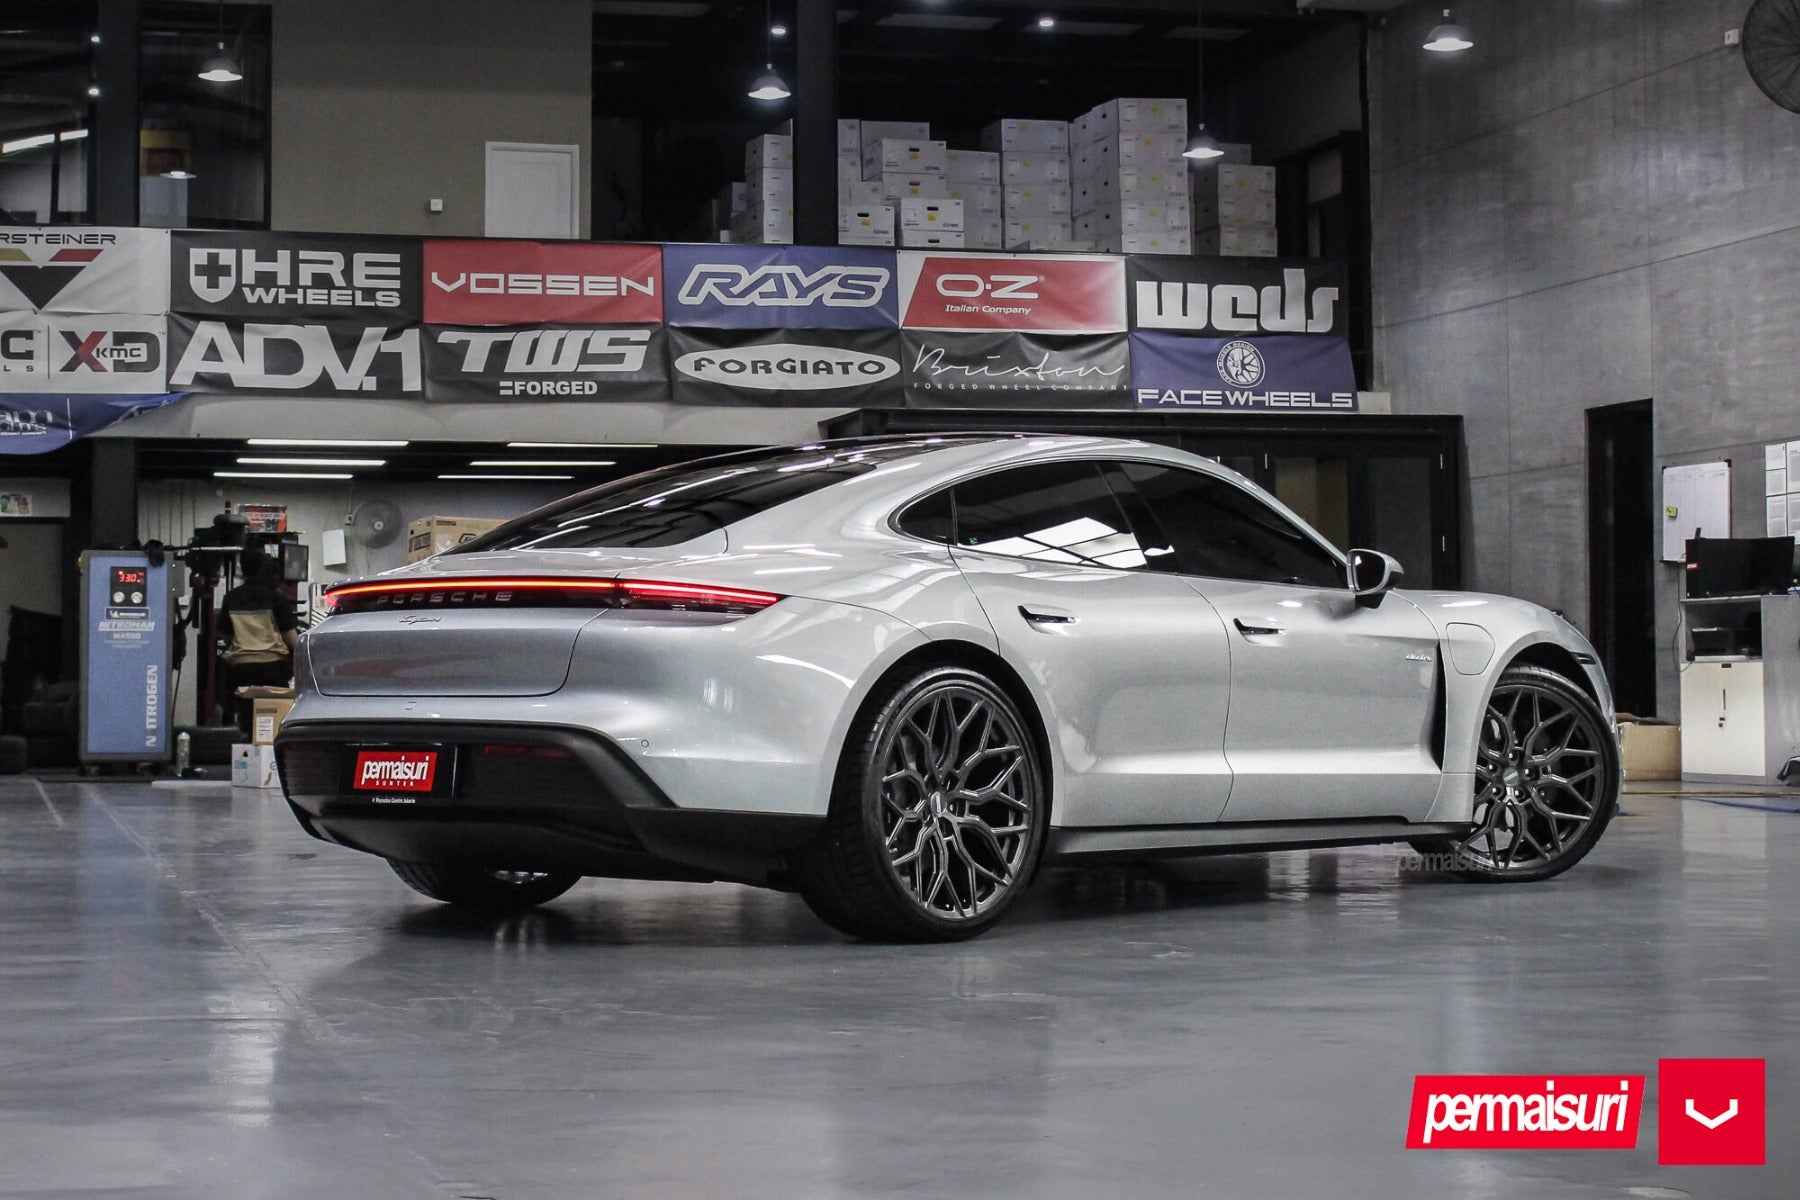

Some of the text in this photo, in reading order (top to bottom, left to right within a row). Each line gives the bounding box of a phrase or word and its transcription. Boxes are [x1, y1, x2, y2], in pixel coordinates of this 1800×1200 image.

[242, 249, 401, 288] HRE
[242, 287, 401, 307] WHEELS
[431, 271, 655, 297] VOSSEN
[677, 263, 890, 307] RAYS
[945, 304, 1032, 315] Italian Company
[1135, 268, 1339, 333] weds
[59, 330, 161, 373] XD
[169, 320, 422, 393] ADV.1
[437, 329, 651, 373] TWS
[912, 344, 1125, 381] Brixton
[693, 357, 887, 376] FORGIATO
[513, 380, 598, 395] FORGED
[913, 382, 978, 390] FORGED
[988, 383, 1041, 391] WHEEL
[376, 591, 514, 604] PORSCHE
[361, 755, 430, 785] permaisuri
